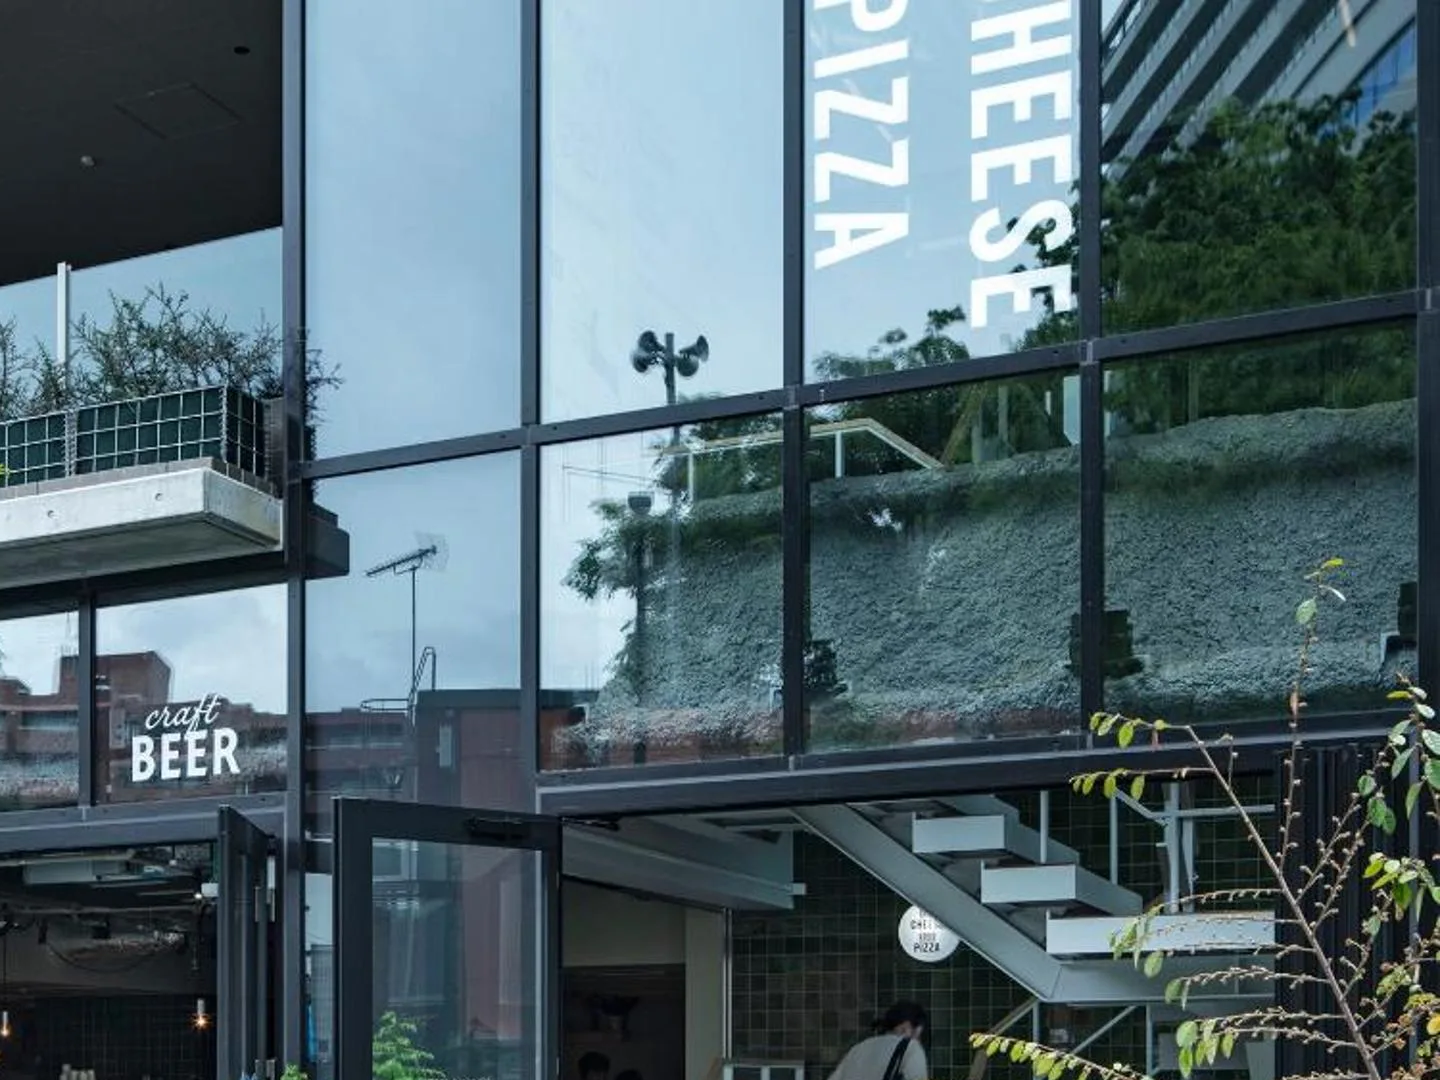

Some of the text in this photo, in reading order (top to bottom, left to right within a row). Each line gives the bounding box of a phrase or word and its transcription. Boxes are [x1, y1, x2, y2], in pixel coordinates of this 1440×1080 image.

[814, 0, 909, 270] PIZZA
[970, 0, 1072, 328] HEESE
[132, 727, 240, 782] BEER
[145, 691, 221, 732] craft
